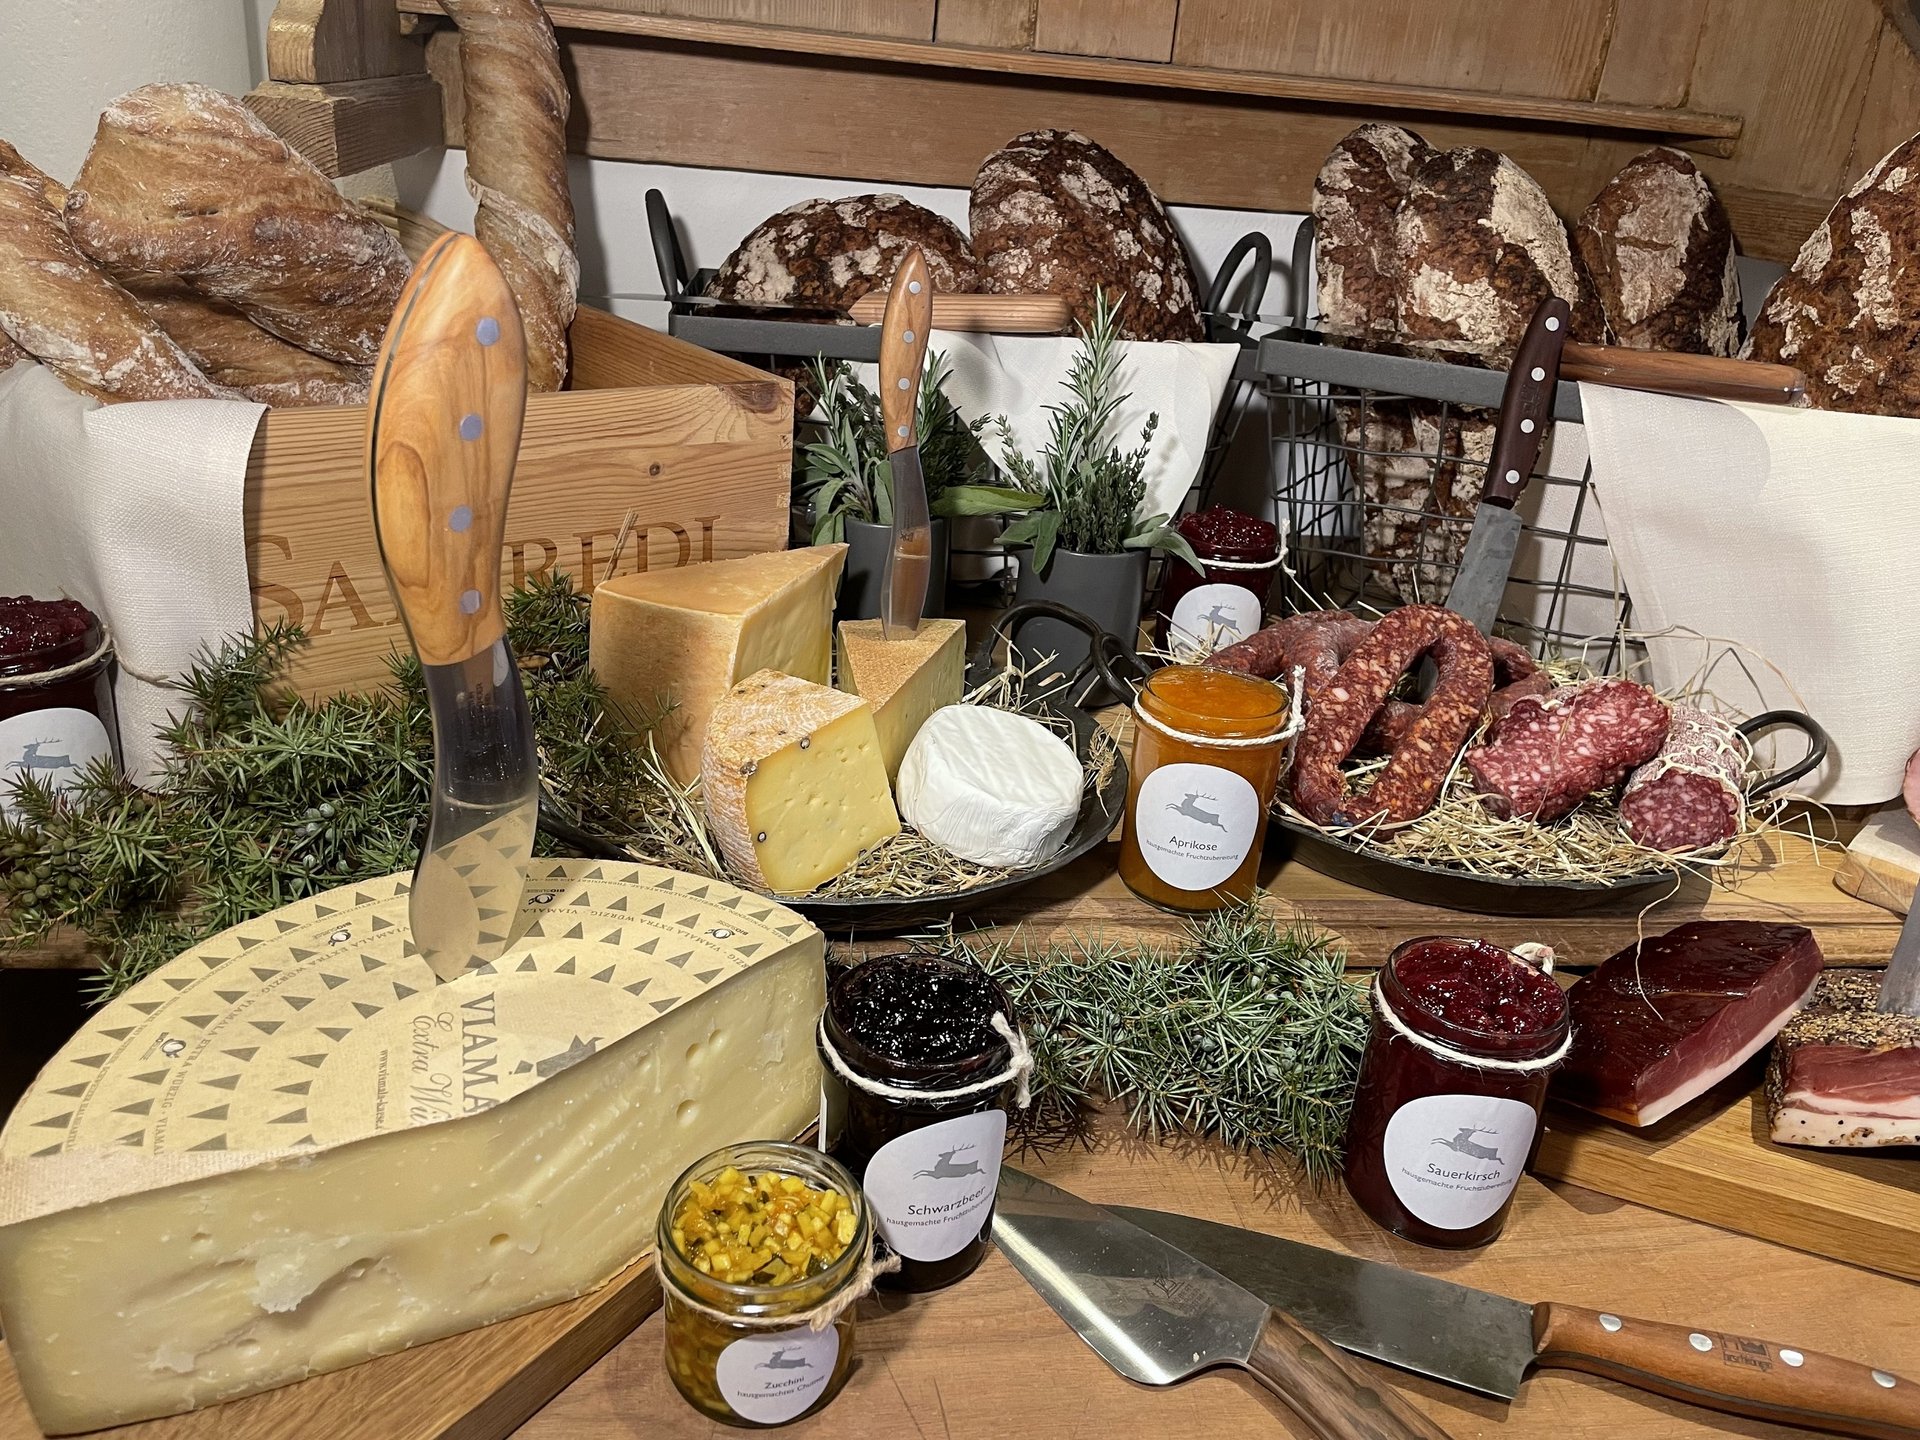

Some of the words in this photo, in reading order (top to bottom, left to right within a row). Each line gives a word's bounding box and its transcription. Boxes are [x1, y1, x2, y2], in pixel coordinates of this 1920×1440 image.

[1146, 839, 1185, 857] hausgemachte
[1168, 835, 1218, 851] Aprikose
[521, 907, 578, 915] VIAMALA
[640, 918, 674, 932] EXTRA
[350, 926, 411, 948] VIAMALA
[676, 929, 722, 953] VIAMALA
[307, 946, 349, 966] EXTRA
[207, 999, 256, 1036] VIAMALA
[181, 1038, 212, 1068] EXTRA
[409, 1012, 454, 1074] Extra
[461, 991, 499, 1114] VIAMA
[409, 1072, 453, 1128] Wü
[1401, 1167, 1455, 1190] hausgemachte
[1426, 1162, 1501, 1181] Sauerkirsch
[908, 1185, 987, 1216] Schwarzbeer
[886, 1217, 942, 1228] hausgemachte
[764, 1375, 805, 1390] Zucchini
